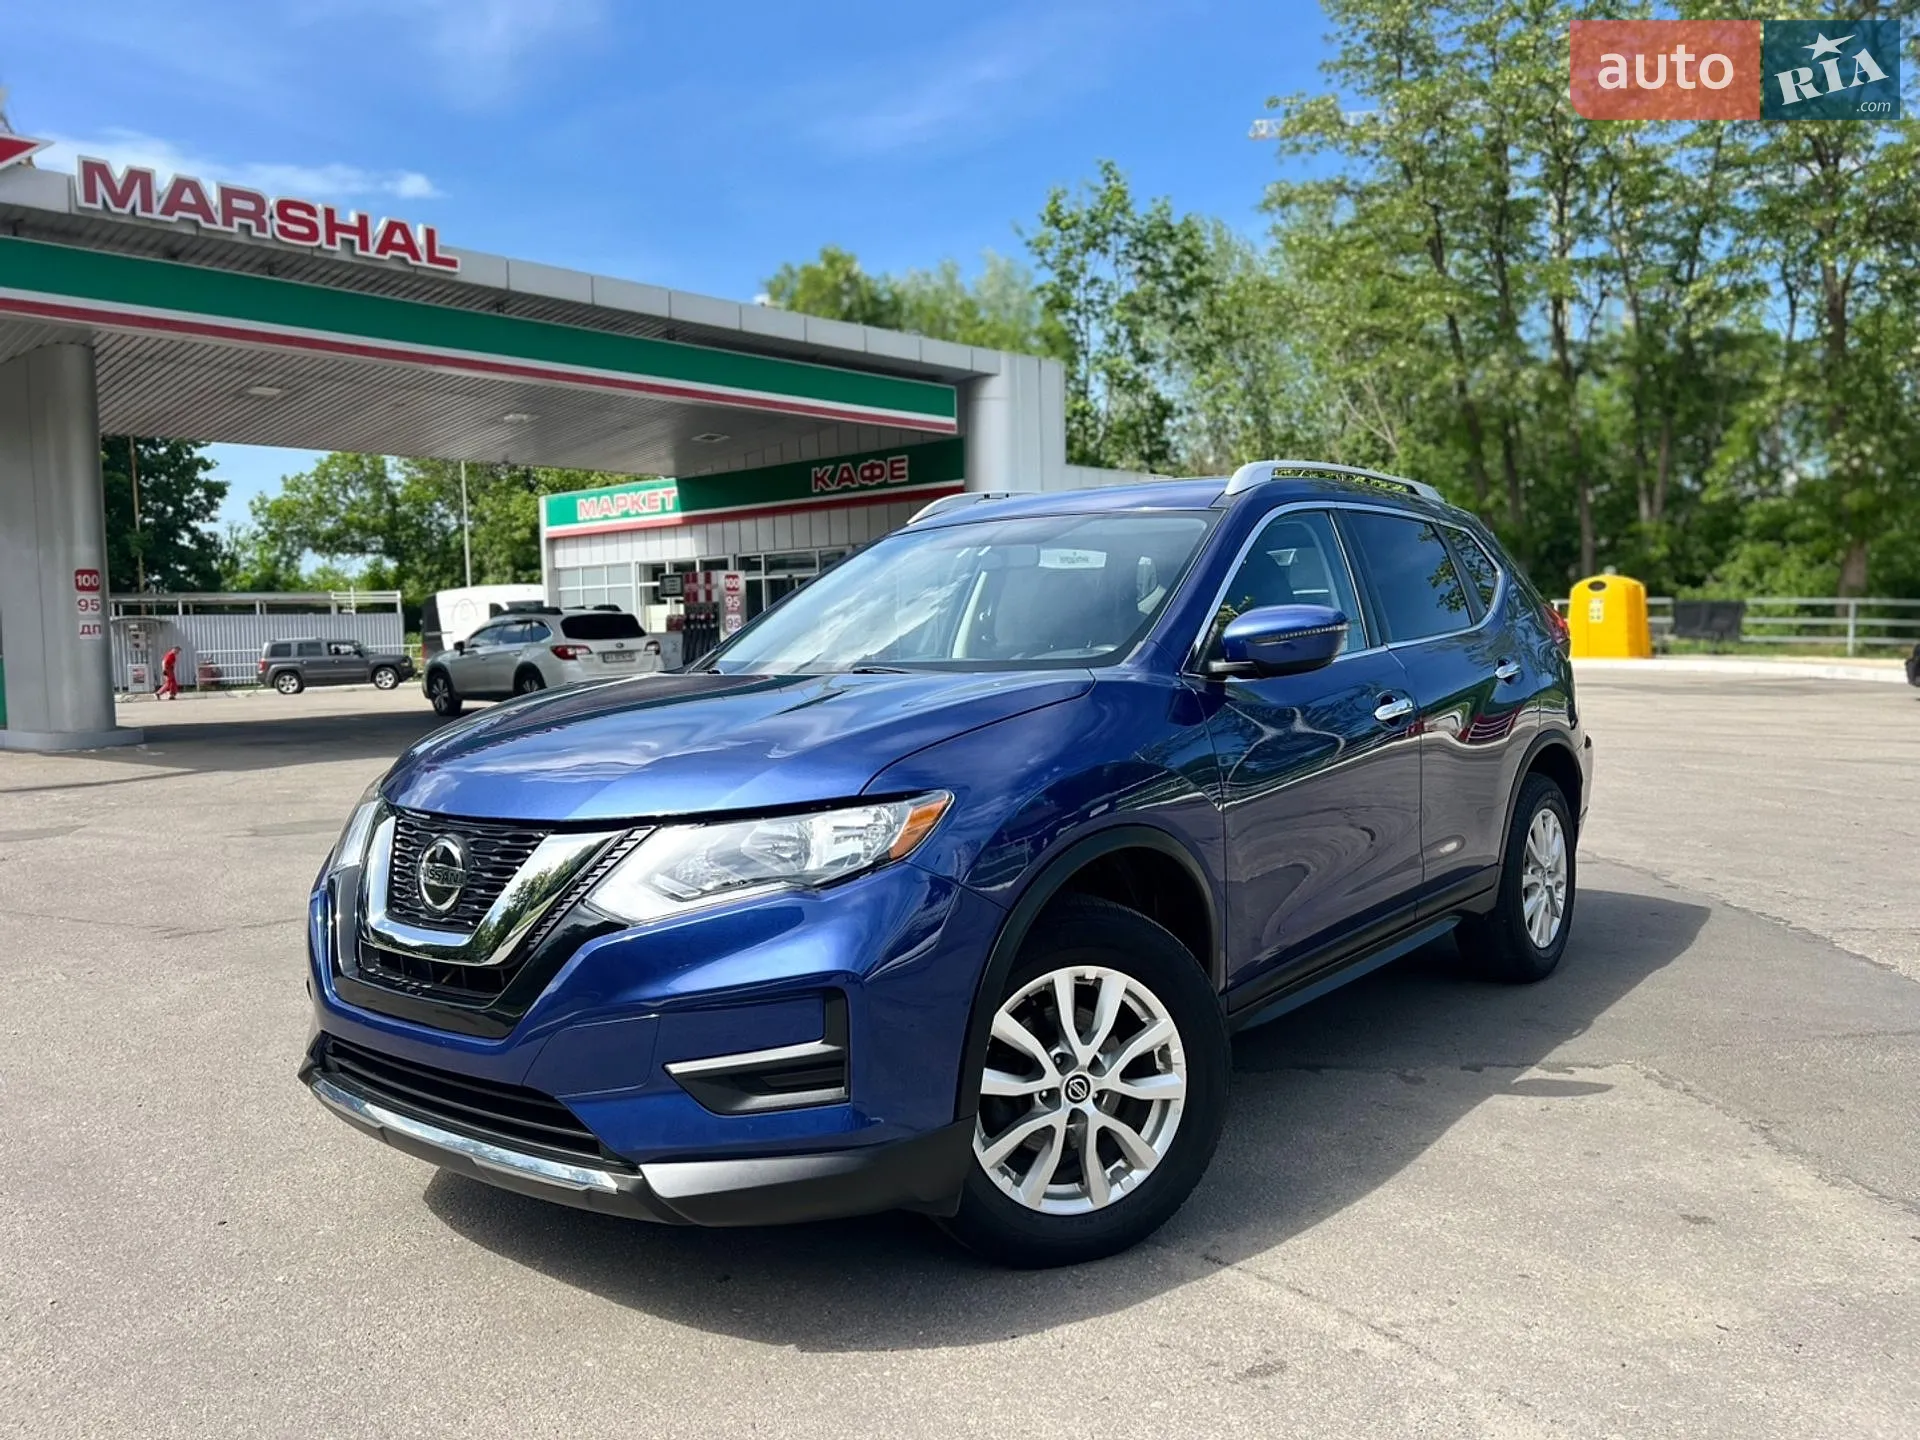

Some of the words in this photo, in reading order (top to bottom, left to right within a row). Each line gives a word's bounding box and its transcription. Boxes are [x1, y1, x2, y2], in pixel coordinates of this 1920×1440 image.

[77, 157, 461, 271] MARSHAL
[811, 455, 909, 493] КАФЕ
[577, 488, 677, 521] МАРКЕТ
[76, 574, 99, 587] 100
[77, 598, 101, 612] 95
[725, 595, 740, 608] 95
